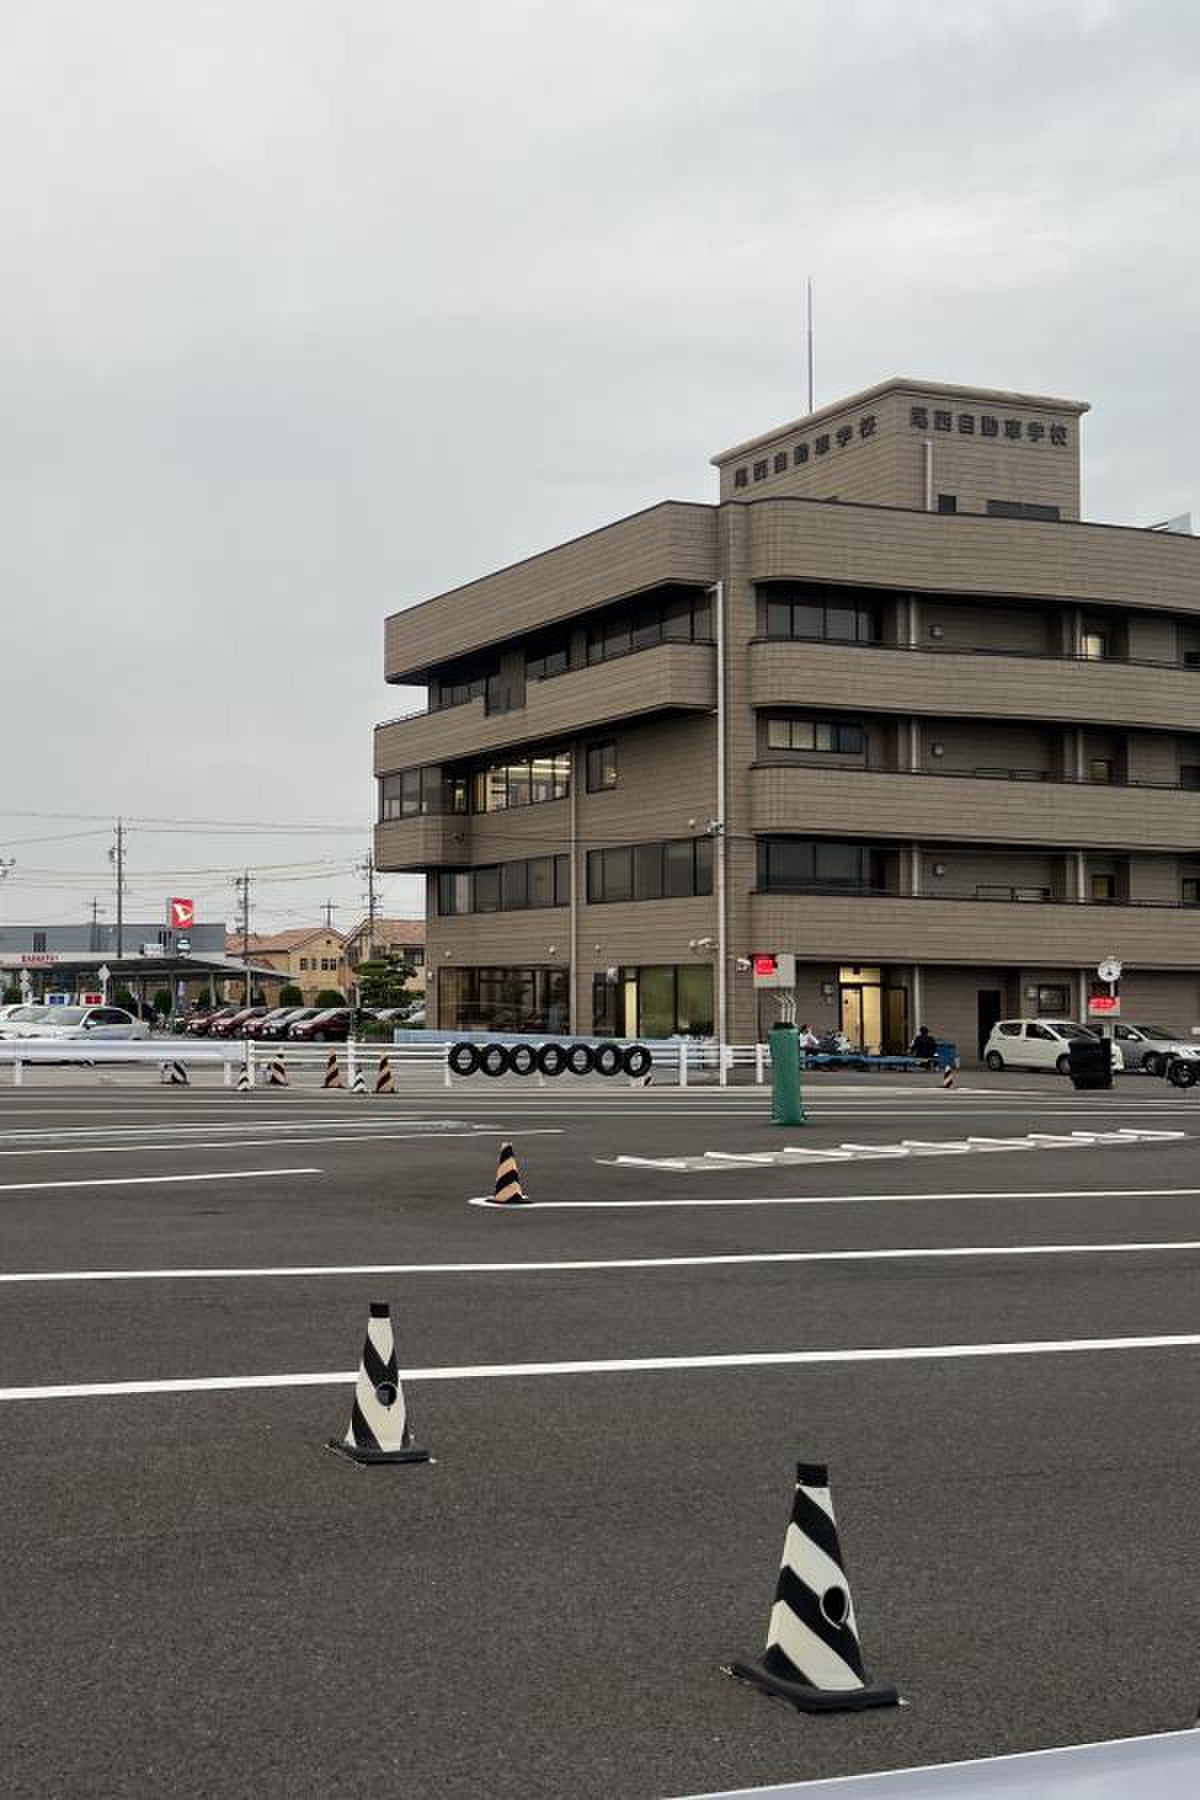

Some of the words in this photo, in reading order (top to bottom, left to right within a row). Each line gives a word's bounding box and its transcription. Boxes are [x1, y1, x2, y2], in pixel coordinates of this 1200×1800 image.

[911, 406, 1067, 446] 尾西自動車学校
